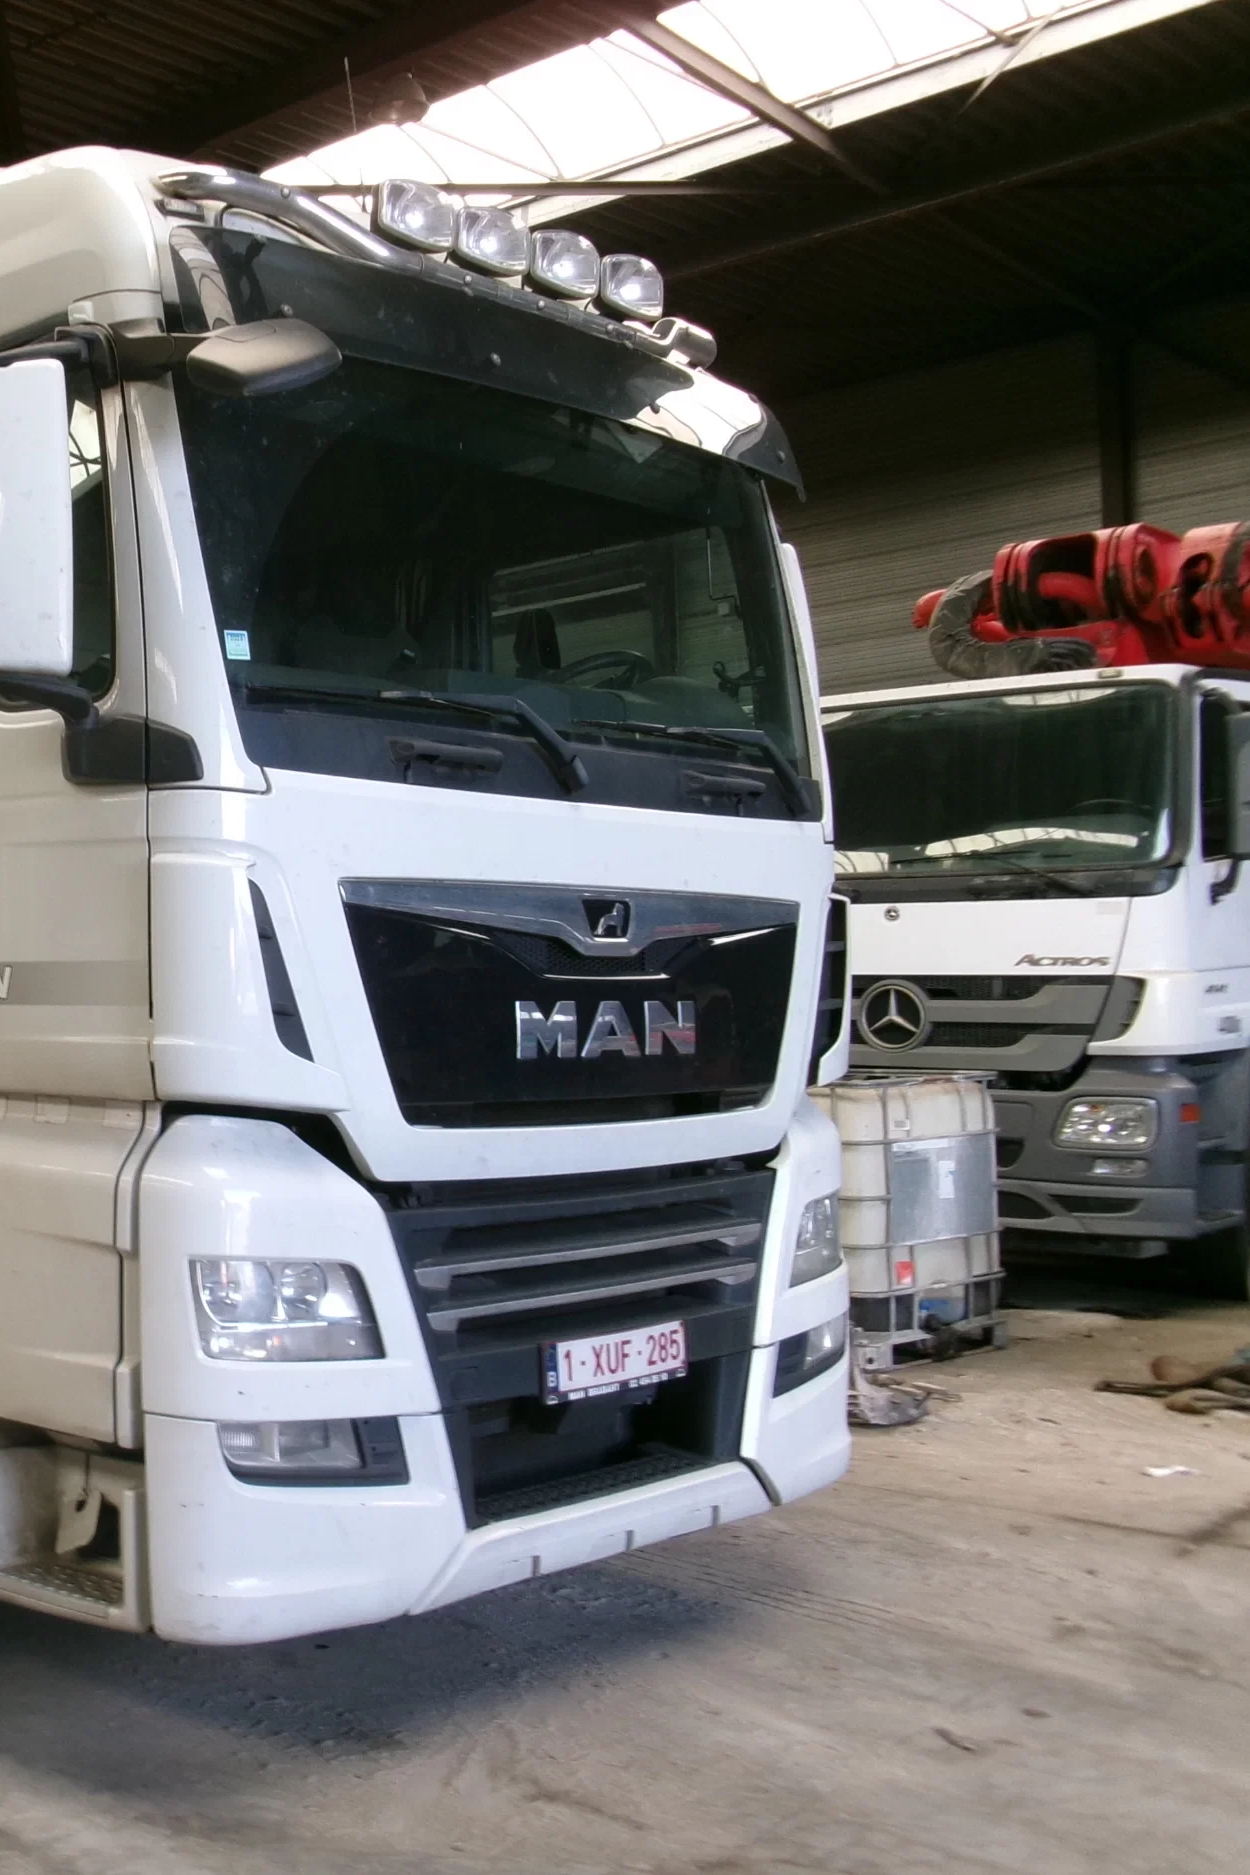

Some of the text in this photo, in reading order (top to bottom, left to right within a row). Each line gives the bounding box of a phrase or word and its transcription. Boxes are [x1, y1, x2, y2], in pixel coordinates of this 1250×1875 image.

[515, 1000, 696, 1059] MAN
[546, 1371, 557, 1387] B
[563, 1329, 681, 1382] 1-XUF-285
